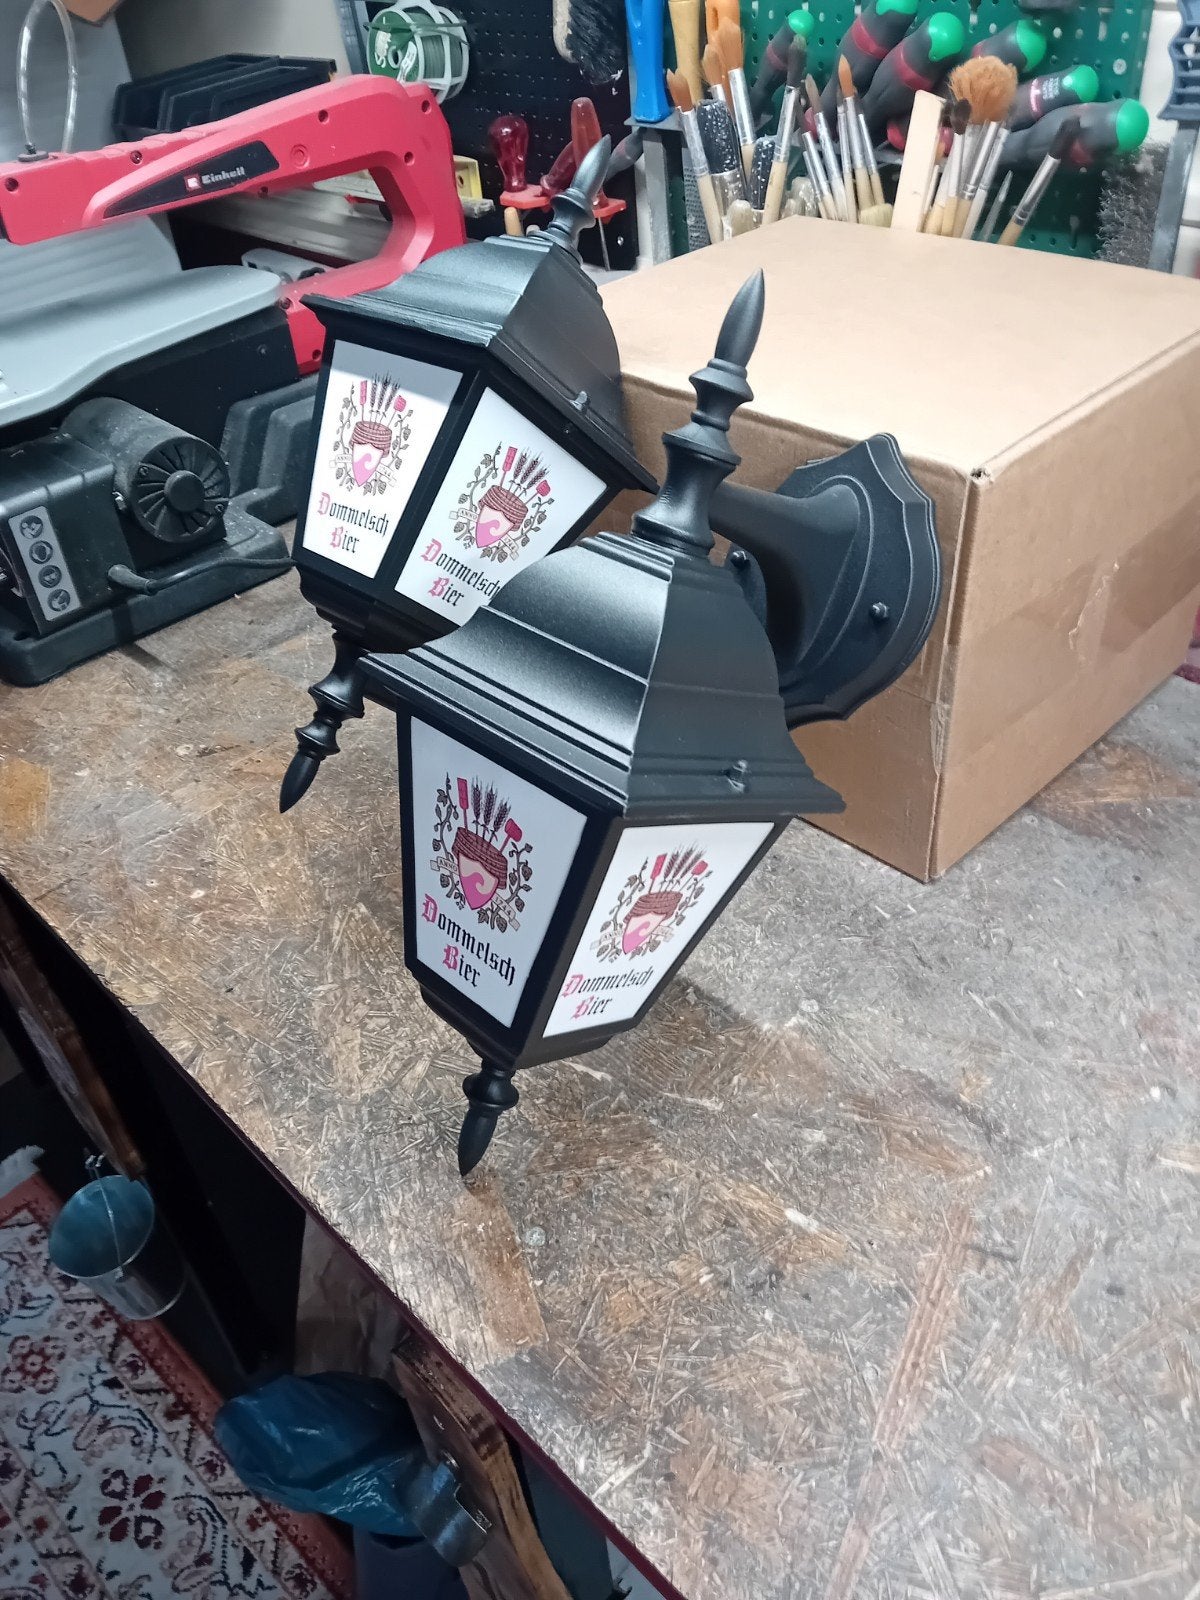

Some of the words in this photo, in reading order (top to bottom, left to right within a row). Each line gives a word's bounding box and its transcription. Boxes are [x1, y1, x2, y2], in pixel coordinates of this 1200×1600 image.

[201, 166, 245, 185] Einhell
[317, 491, 389, 537] Dommelsch
[330, 526, 360, 553] Bier
[421, 538, 500, 600] Dommelsch
[428, 577, 464, 606] Bier
[422, 893, 515, 986] Dommelsch
[443, 944, 480, 987] Bier
[561, 966, 654, 997] Dommelsch
[570, 995, 612, 1019] Bier
